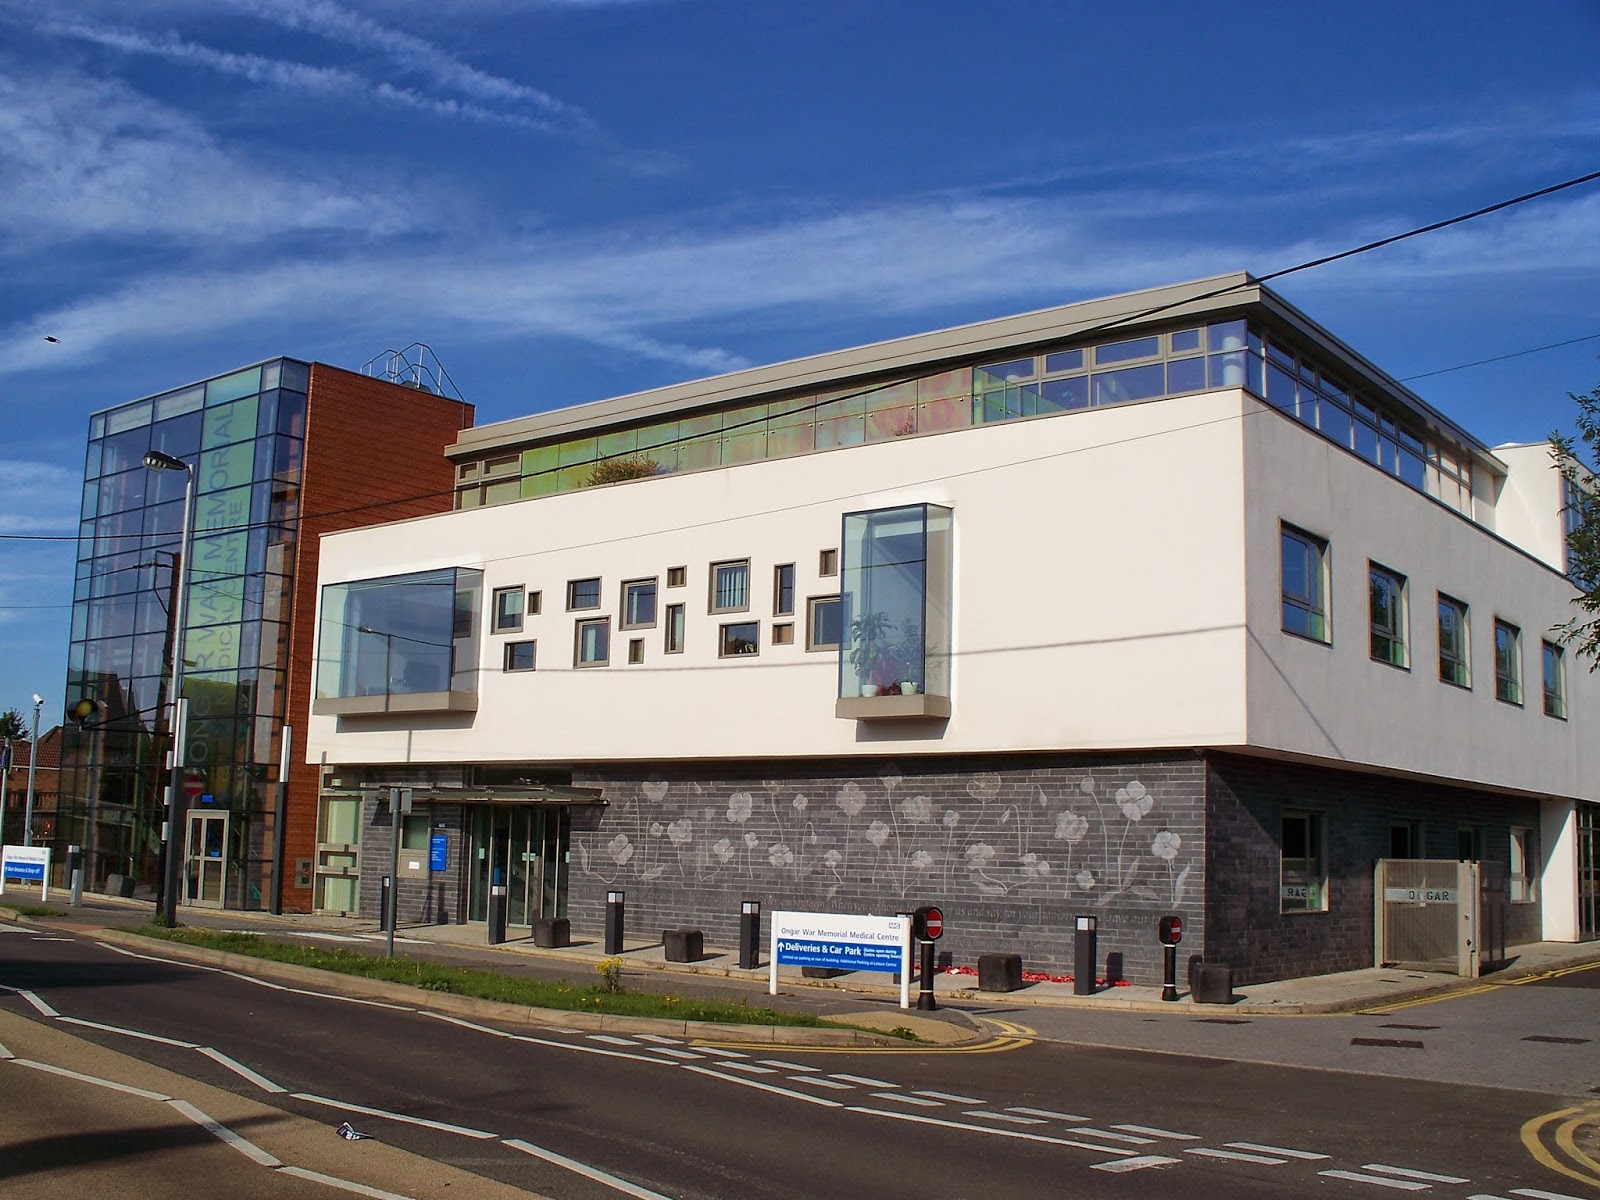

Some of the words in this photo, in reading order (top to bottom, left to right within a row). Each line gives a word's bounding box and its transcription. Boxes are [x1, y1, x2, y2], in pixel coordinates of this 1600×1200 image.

[224, 501, 241, 594] CENTRE
[189, 650, 214, 762] ONGR
[781, 927, 800, 936] Ongar
[818, 930, 847, 938] Memorial
[850, 931, 874, 939] Medical
[877, 933, 899, 941] Centre
[785, 942, 820, 953] Deliveries
[822, 945, 828, 953] &
[830, 946, 842, 954] Car
[845, 946, 861, 956] Park
